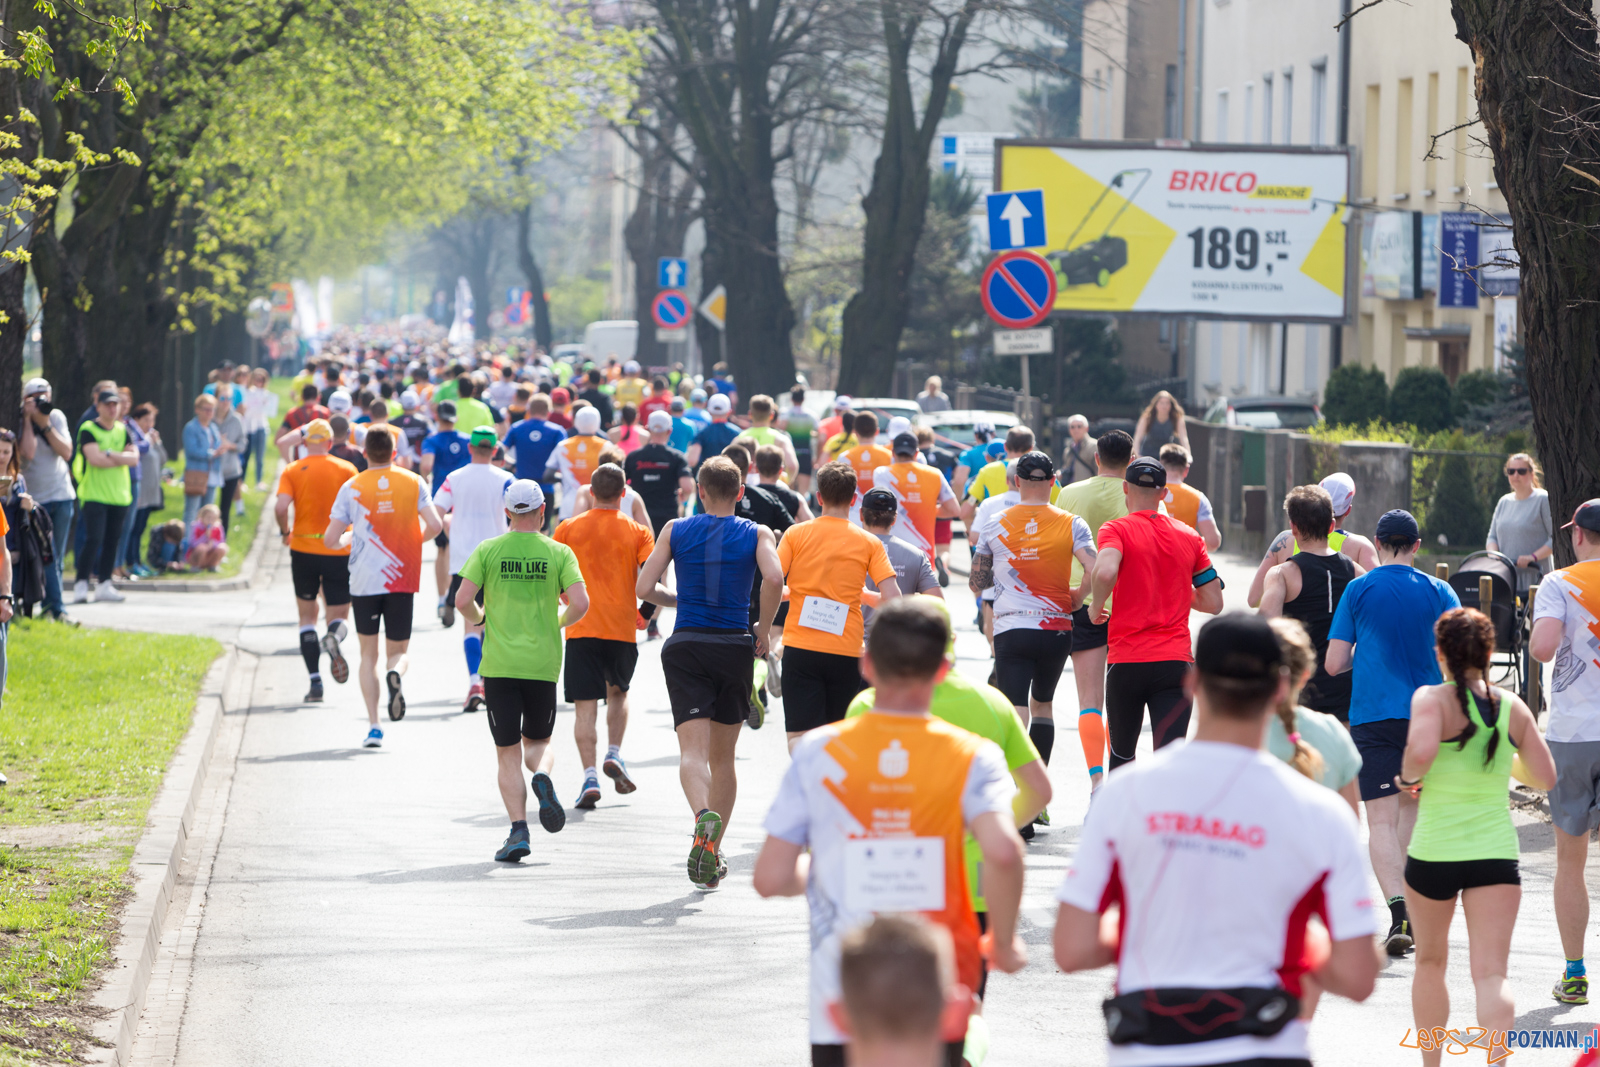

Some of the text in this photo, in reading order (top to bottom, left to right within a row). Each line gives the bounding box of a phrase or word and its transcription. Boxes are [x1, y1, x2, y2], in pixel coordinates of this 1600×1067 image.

[1168, 170, 1257, 193] BRICO
[1265, 229, 1291, 245] szt.
[501, 561, 548, 574] RUN LIKE
[1146, 812, 1266, 850] STRABAG
